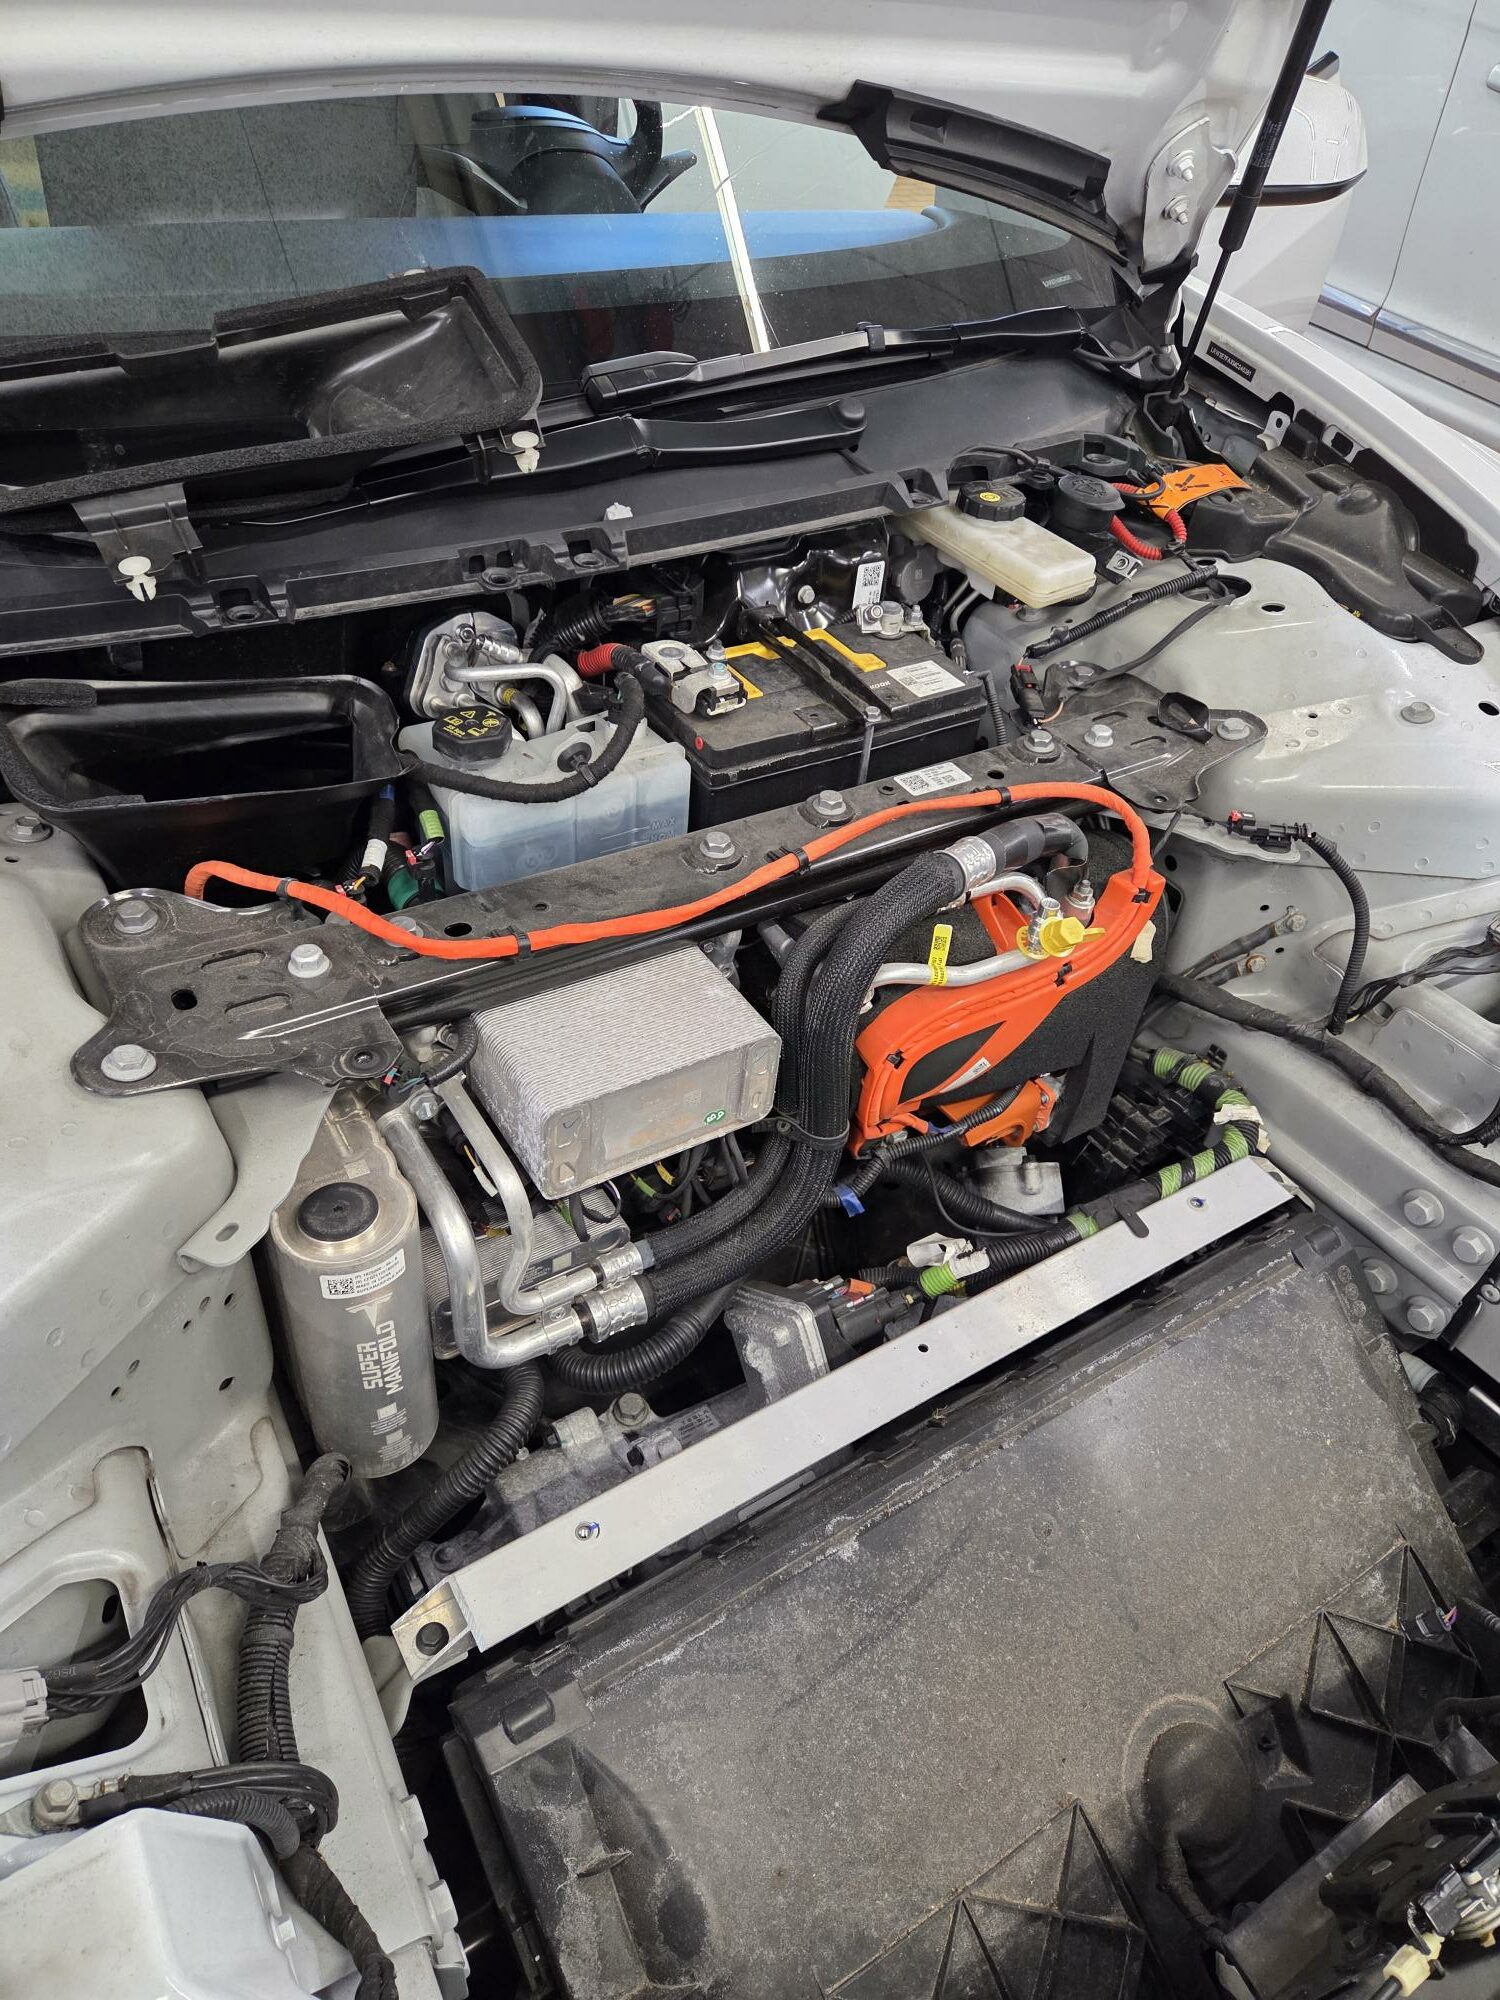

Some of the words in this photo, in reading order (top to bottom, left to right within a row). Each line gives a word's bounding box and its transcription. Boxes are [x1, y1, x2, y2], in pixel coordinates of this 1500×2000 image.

[650, 815, 677, 831] MAX
[356, 1341, 384, 1390] SUPER
[375, 1319, 404, 1396] MANIFOLD
